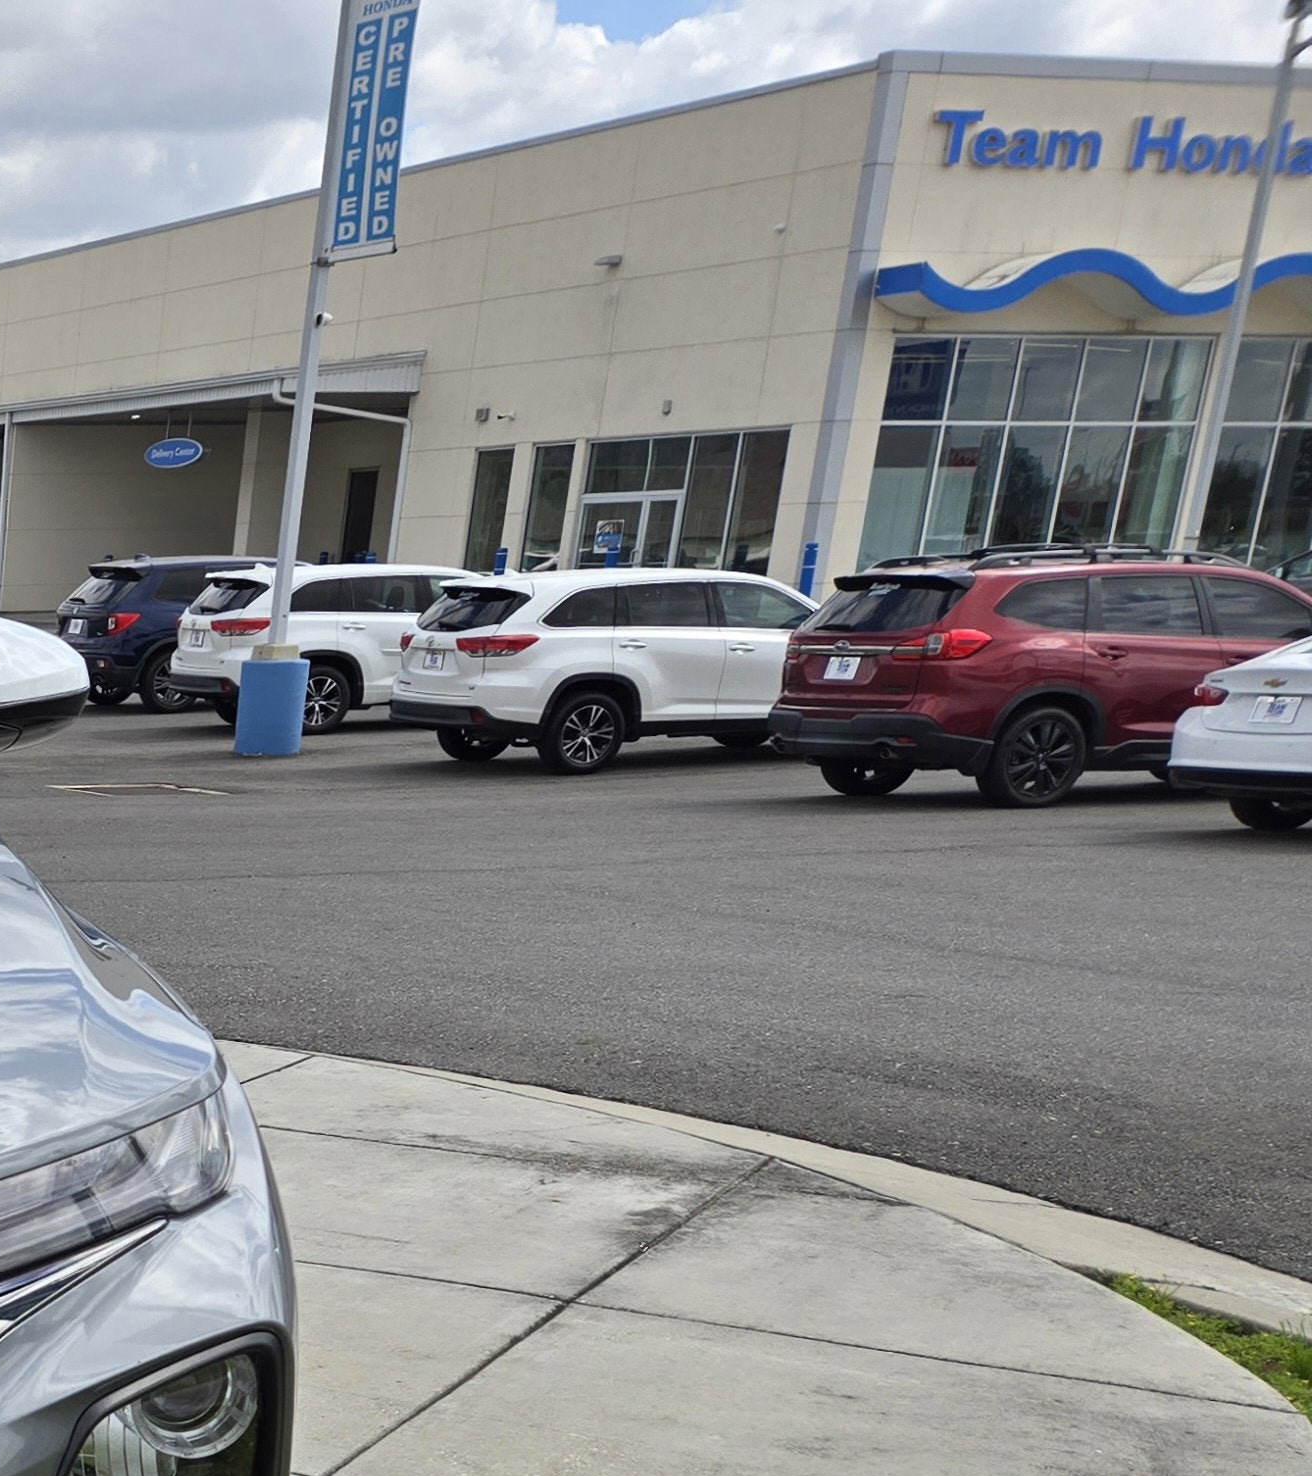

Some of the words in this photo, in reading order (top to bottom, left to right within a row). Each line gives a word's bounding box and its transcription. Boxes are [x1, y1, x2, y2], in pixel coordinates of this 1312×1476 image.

[385, 17, 409, 88] PRE
[337, 25, 377, 241] CERTIFIED
[372, 116, 398, 236] OWNED
[933, 109, 1103, 168] Team
